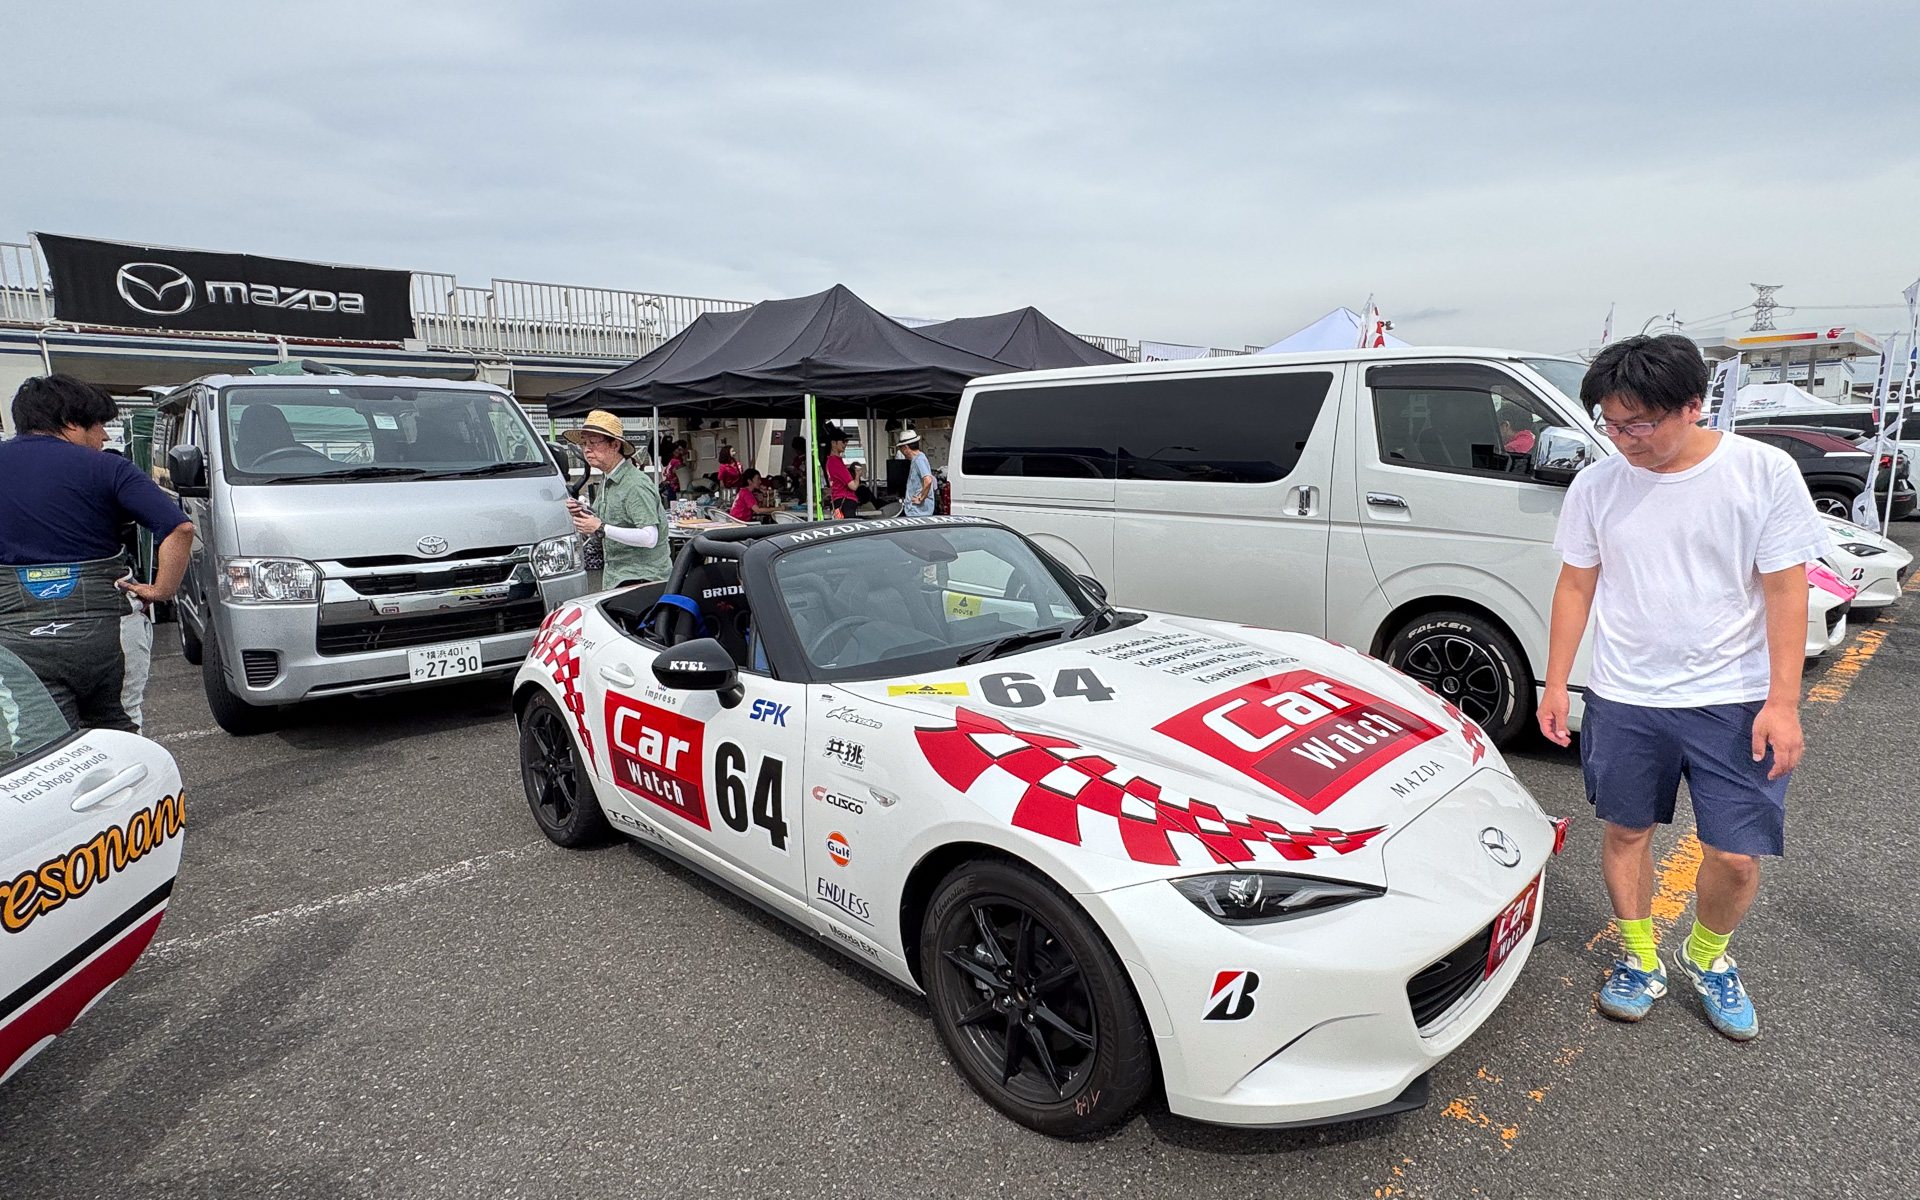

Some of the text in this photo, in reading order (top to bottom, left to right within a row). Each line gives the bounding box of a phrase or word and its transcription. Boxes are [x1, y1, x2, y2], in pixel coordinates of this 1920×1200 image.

[205, 280, 365, 315] mazda
[790, 515, 990, 543] MAZDA SPIRIT RACING
[952, 607, 974, 617] mouse
[1407, 621, 1472, 639] FALKEN
[415, 656, 478, 678] わ 27-90
[669, 660, 707, 671] KTEL
[1162, 657, 1228, 676] Ishikawa
[645, 685, 677, 705] impress
[979, 667, 1116, 708] 64
[750, 698, 792, 727] SPK
[1202, 681, 1352, 752] Car
[613, 706, 690, 772] Car
[826, 739, 864, 766] 共挑
[1291, 711, 1403, 770] Watch
[0, 769, 37, 793] Robert
[37, 755, 70, 779] Torao
[11, 752, 108, 805] Teru Shogo Haruto
[626, 759, 685, 807] Watch
[1390, 760, 1444, 798] MAZDA
[715, 741, 788, 851] 64
[827, 840, 850, 859] Gulf
[817, 876, 870, 919] ENDLESS
[1497, 887, 1535, 944] Car
[1499, 920, 1525, 960] Watch
